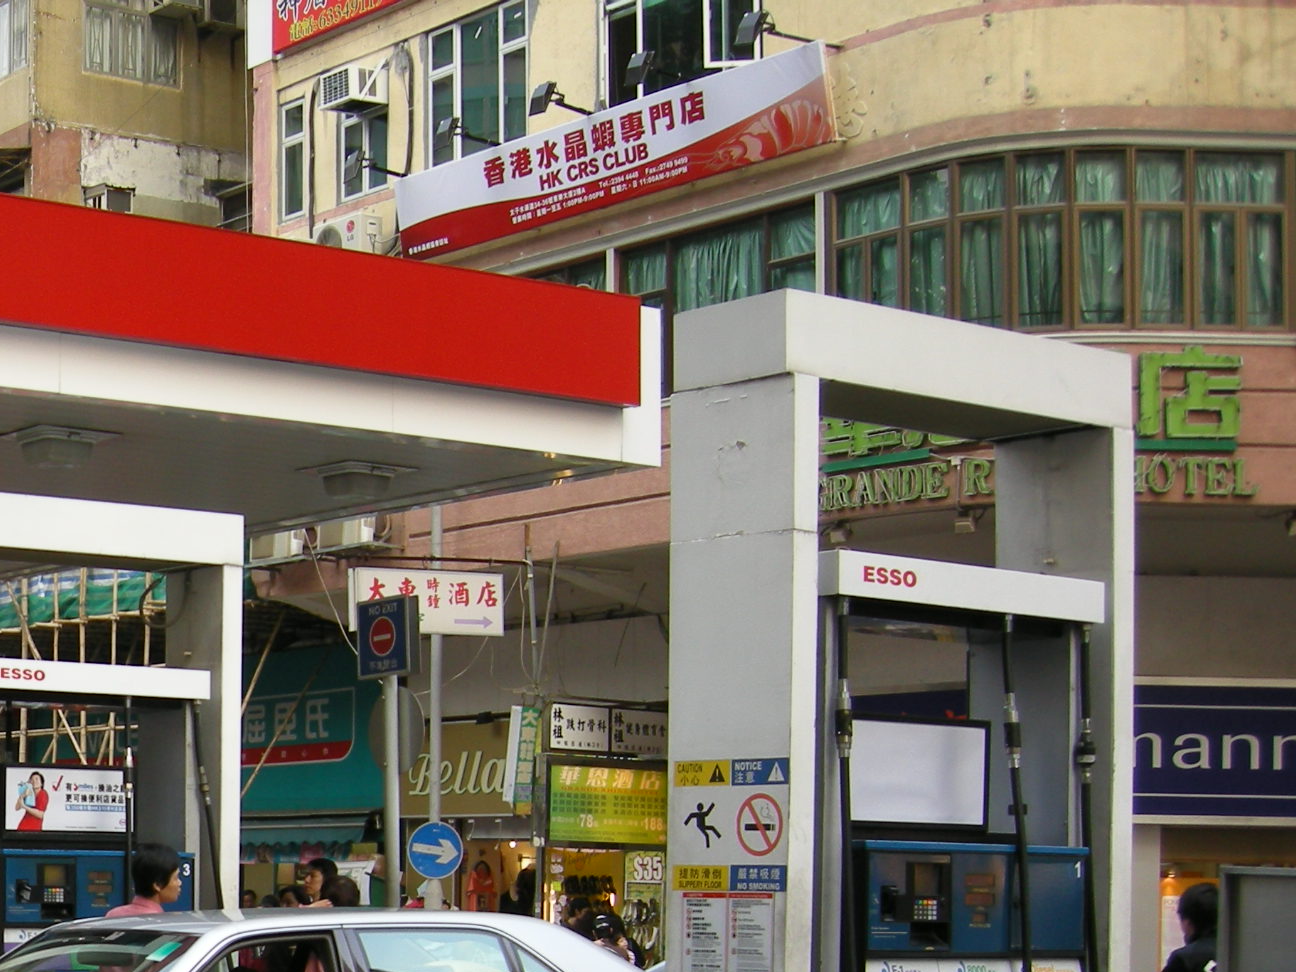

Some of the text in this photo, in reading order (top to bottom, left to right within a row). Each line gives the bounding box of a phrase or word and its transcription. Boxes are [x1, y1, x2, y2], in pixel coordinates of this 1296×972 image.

[483, 91, 705, 189] 香港水晶蝦專門店
[539, 143, 649, 191] HK CRS CLUB
[863, 565, 917, 588] ESSO
[368, 602, 398, 617] NO EXIT
[0, 667, 46, 681] ESSO
[677, 764, 703, 774] CAUTION
[734, 761, 762, 771] NOTICE
[408, 751, 506, 796] Bella
[680, 775, 700, 786] 小心
[734, 772, 755, 784] 注意
[182, 863, 191, 877] 3
[633, 855, 663, 881] $35
[1074, 862, 1081, 878] 1
[679, 881, 703, 889] SLIPPERY
[748, 883, 780, 891] SMOKING
